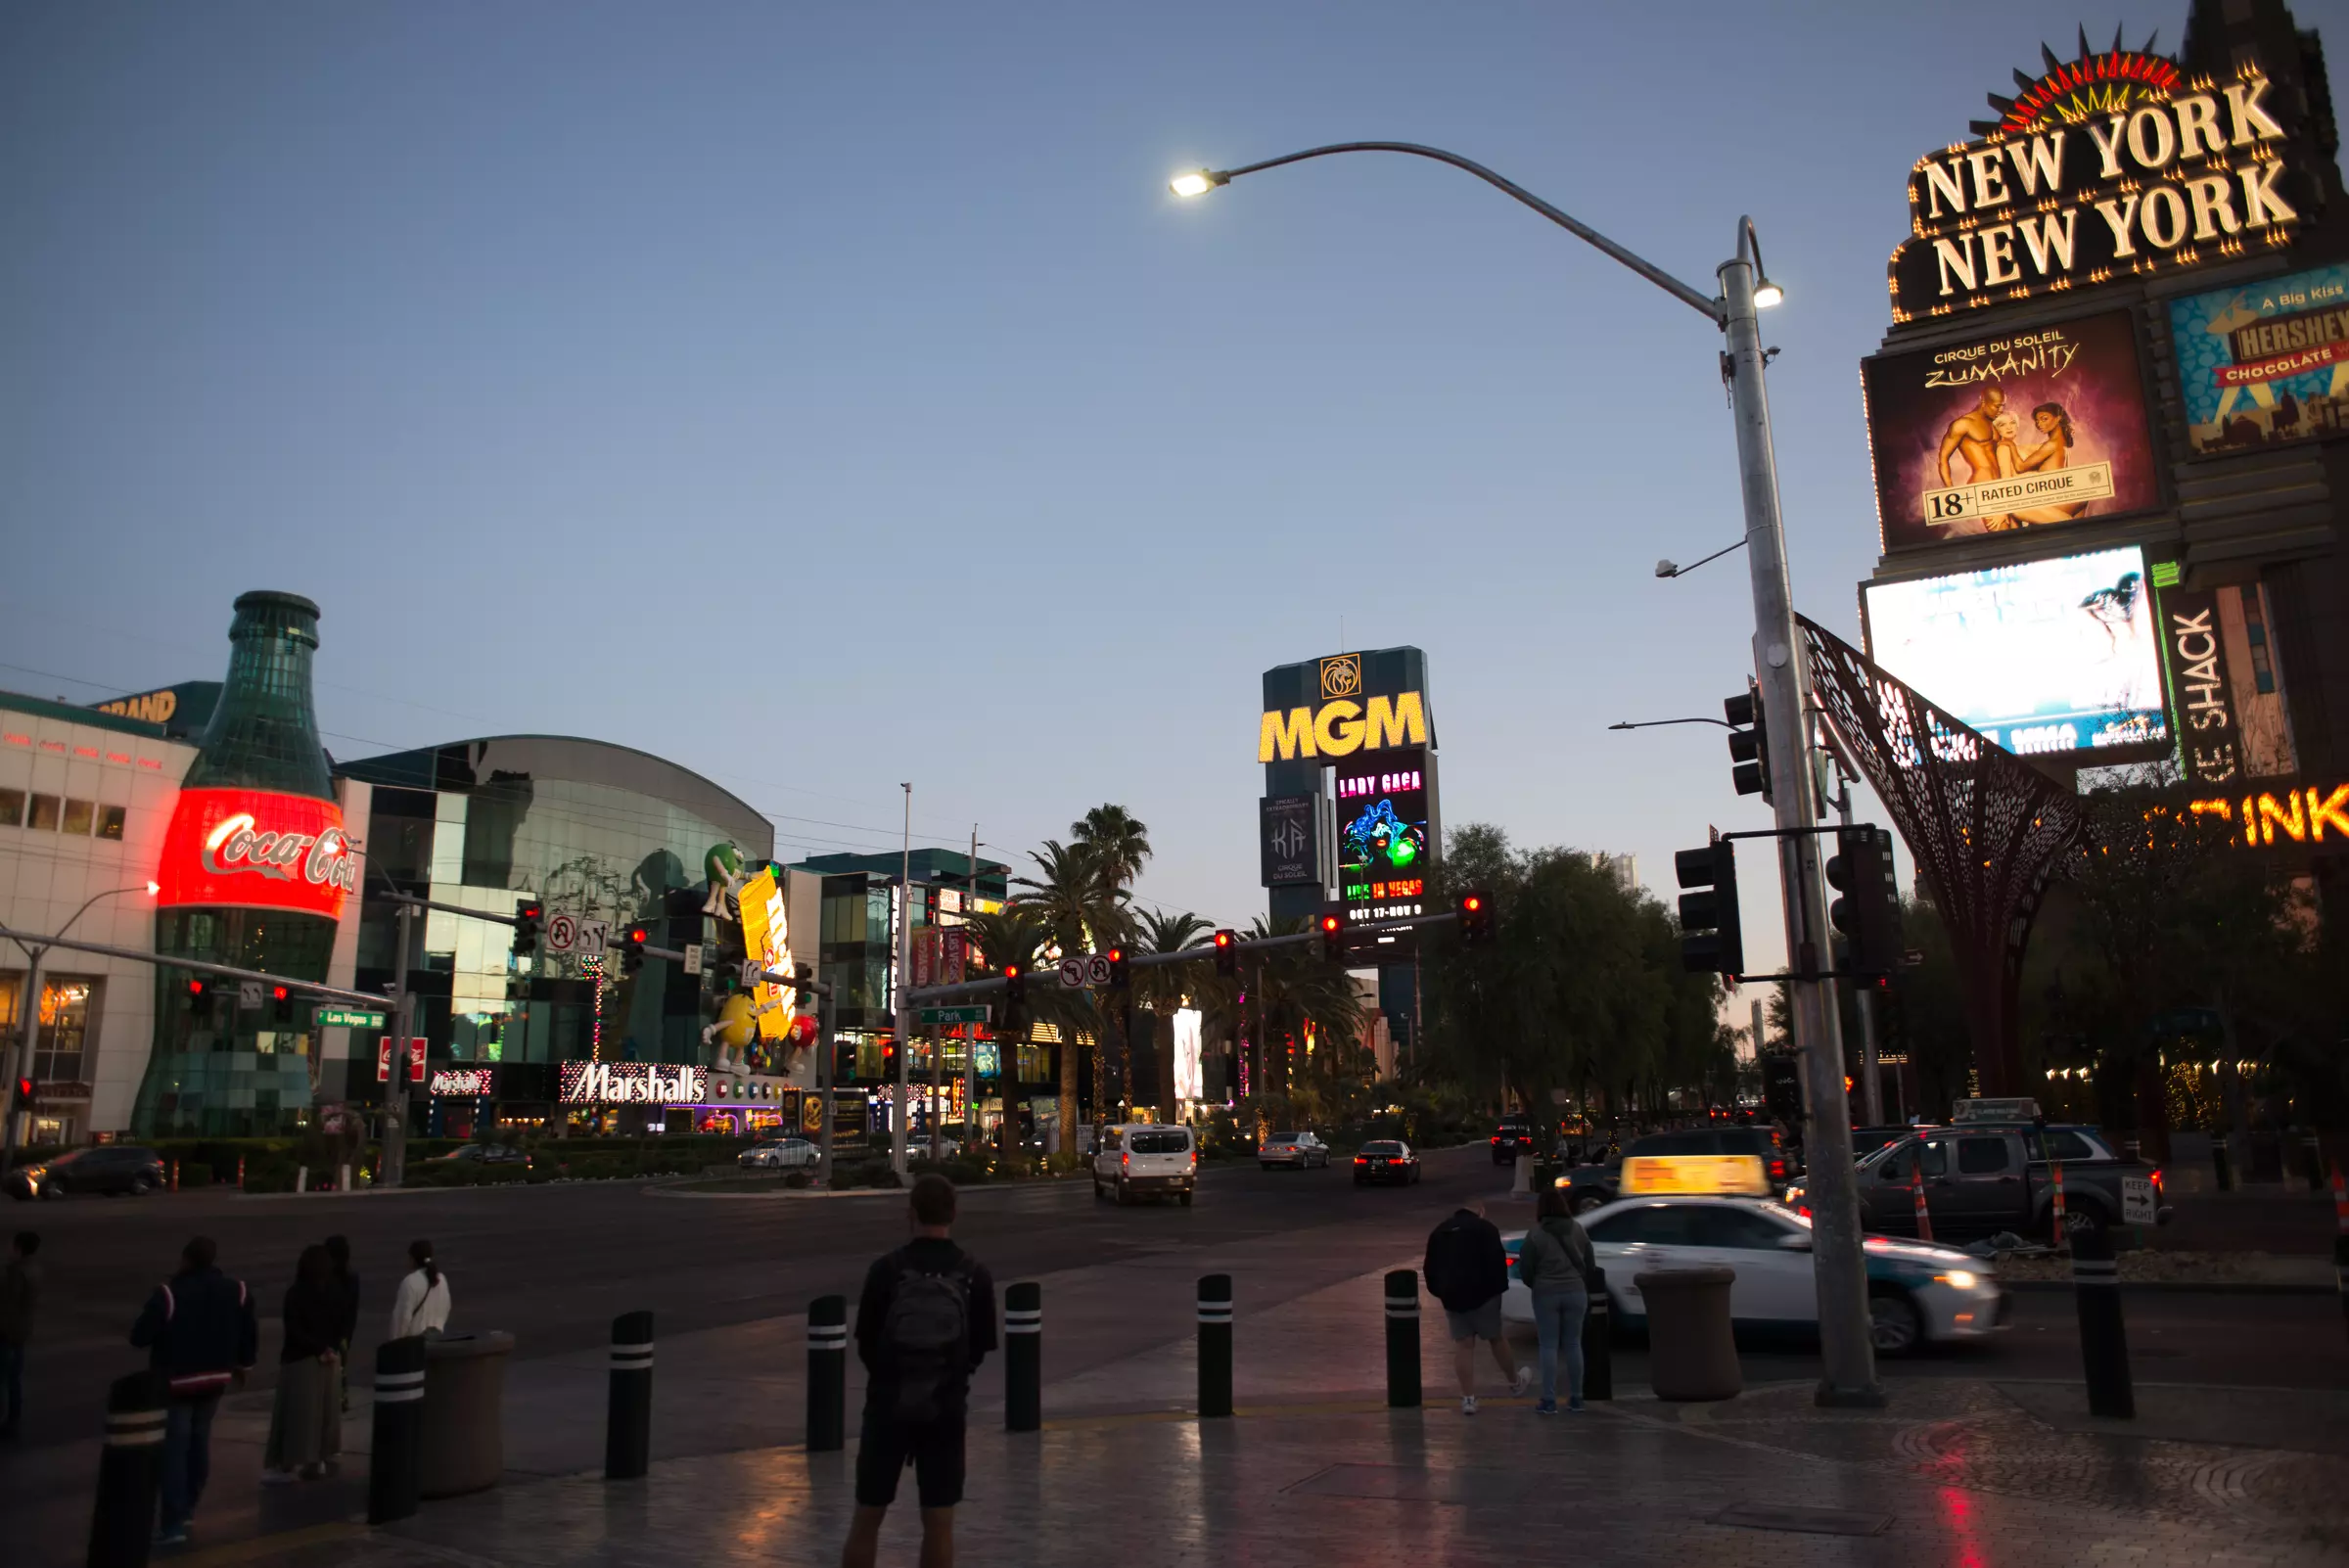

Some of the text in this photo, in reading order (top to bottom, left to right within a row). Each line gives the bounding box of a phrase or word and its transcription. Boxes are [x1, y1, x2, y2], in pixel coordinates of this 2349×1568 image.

[1922, 76, 2288, 220] NEW YORK
[1932, 160, 2299, 297] NEW YORK
[2262, 298, 2275, 309] A
[2311, 285, 2344, 300] Kiss
[1934, 330, 2065, 364] CIRQUE DU SOLEIL
[1924, 343, 2080, 389] ZUMANITY
[2225, 347, 2333, 381] CHOCOLATE
[1930, 490, 1975, 519] 18+
[1981, 483, 2023, 501] RATED
[2026, 476, 2074, 494] CIRQUE
[2173, 608, 2229, 730] SHACK
[1258, 690, 1428, 763] MGM
[1339, 771, 1421, 798] LADY GAGA
[1277, 862, 1304, 872] CIRQUE
[1284, 870, 1308, 879] SOLEIL
[1372, 882, 1385, 899] IN
[1388, 879, 1423, 898] VEGAS
[973, 897, 1004, 915] UBWAY
[1349, 908, 1370, 920] OCT
[327, 1011, 342, 1022] Las
[344, 1012, 368, 1026] Vegas
[938, 1010, 961, 1021] Park
[430, 1072, 481, 1090] Marshalls
[571, 1063, 705, 1101] Marshalls
[2125, 1180, 2150, 1191] KEEP
[2125, 1209, 2153, 1221] RIGHT
